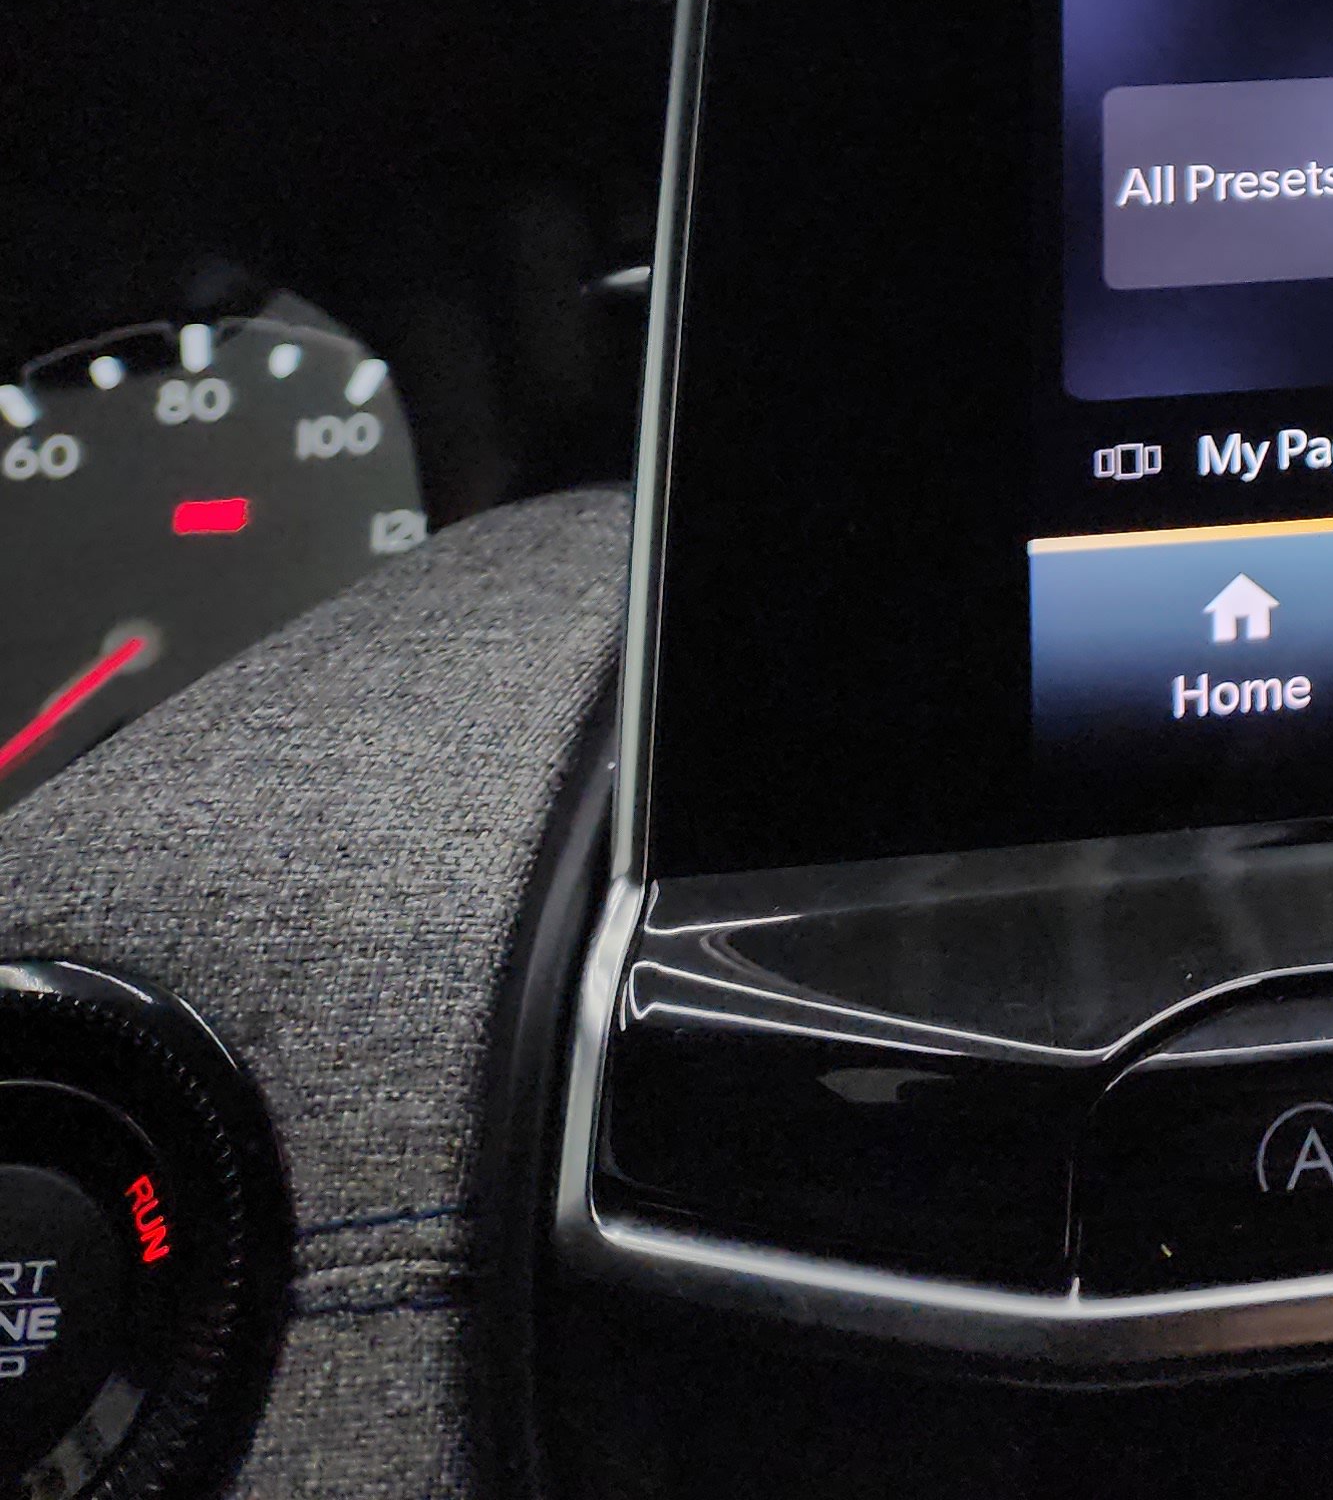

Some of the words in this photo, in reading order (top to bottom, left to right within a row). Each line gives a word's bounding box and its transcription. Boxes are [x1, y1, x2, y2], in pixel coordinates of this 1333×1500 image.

[1116, 165, 1175, 207] All
[155, 377, 232, 424] 80
[2, 434, 81, 481] 60
[296, 412, 381, 460] 100
[1198, 431, 1271, 482] My
[1172, 672, 1312, 719] Home
[124, 1173, 171, 1263] RUN
